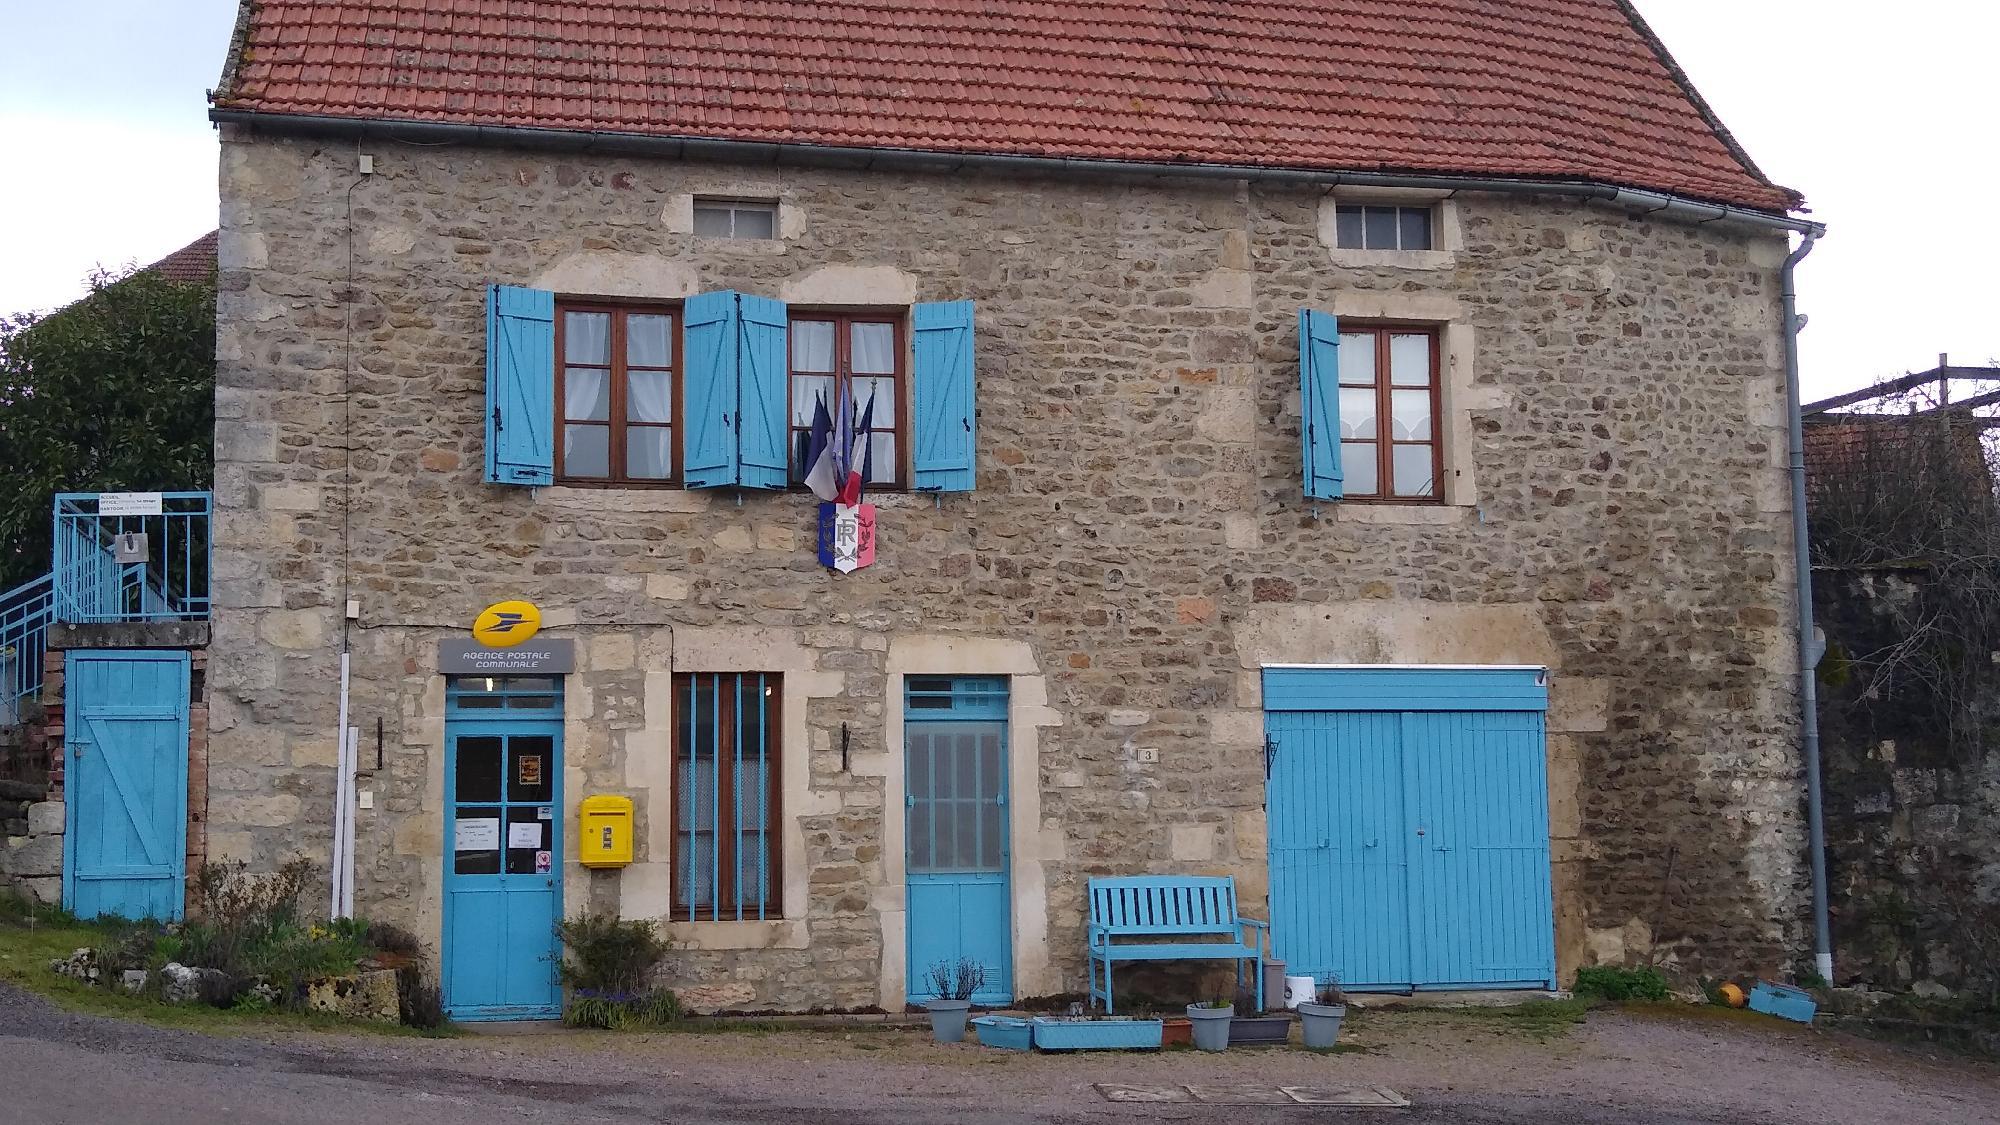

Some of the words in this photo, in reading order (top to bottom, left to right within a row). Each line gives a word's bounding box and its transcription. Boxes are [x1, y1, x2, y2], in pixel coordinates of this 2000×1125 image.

[462, 652, 505, 660] AGENCE
[507, 652, 552, 660] POSTALE
[1145, 751, 1152, 760] 3
